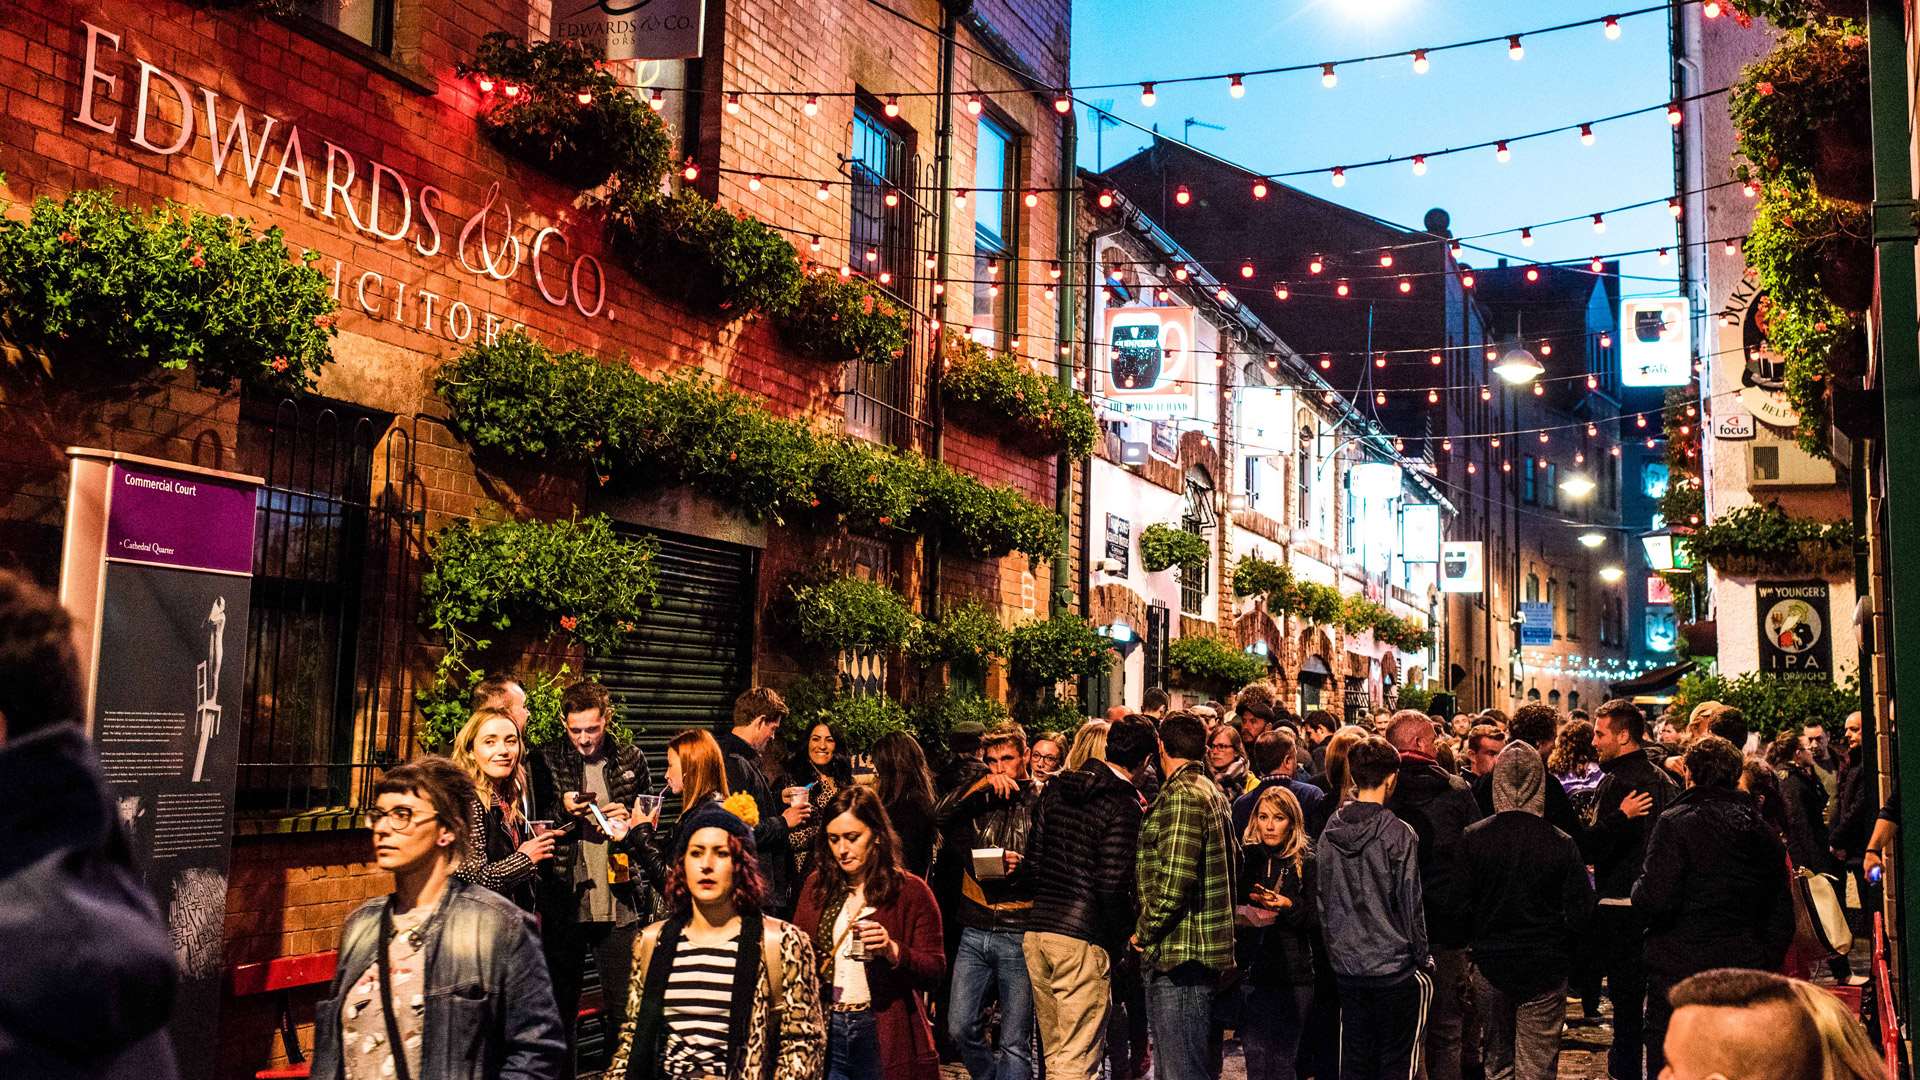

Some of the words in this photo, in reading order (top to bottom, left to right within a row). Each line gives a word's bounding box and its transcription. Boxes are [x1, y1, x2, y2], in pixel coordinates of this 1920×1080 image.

[557, 20, 637, 38] EDWARDS
[664, 14, 695, 32] CO.
[73, 20, 441, 256] EDWARDS
[459, 181, 520, 280] &
[534, 226, 616, 320] CO.
[1720, 425, 1749, 435] focus
[125, 474, 173, 492] Commercial
[175, 483, 197, 496] Court
[123, 539, 151, 552] Cathedral
[152, 543, 174, 555] Quarter
